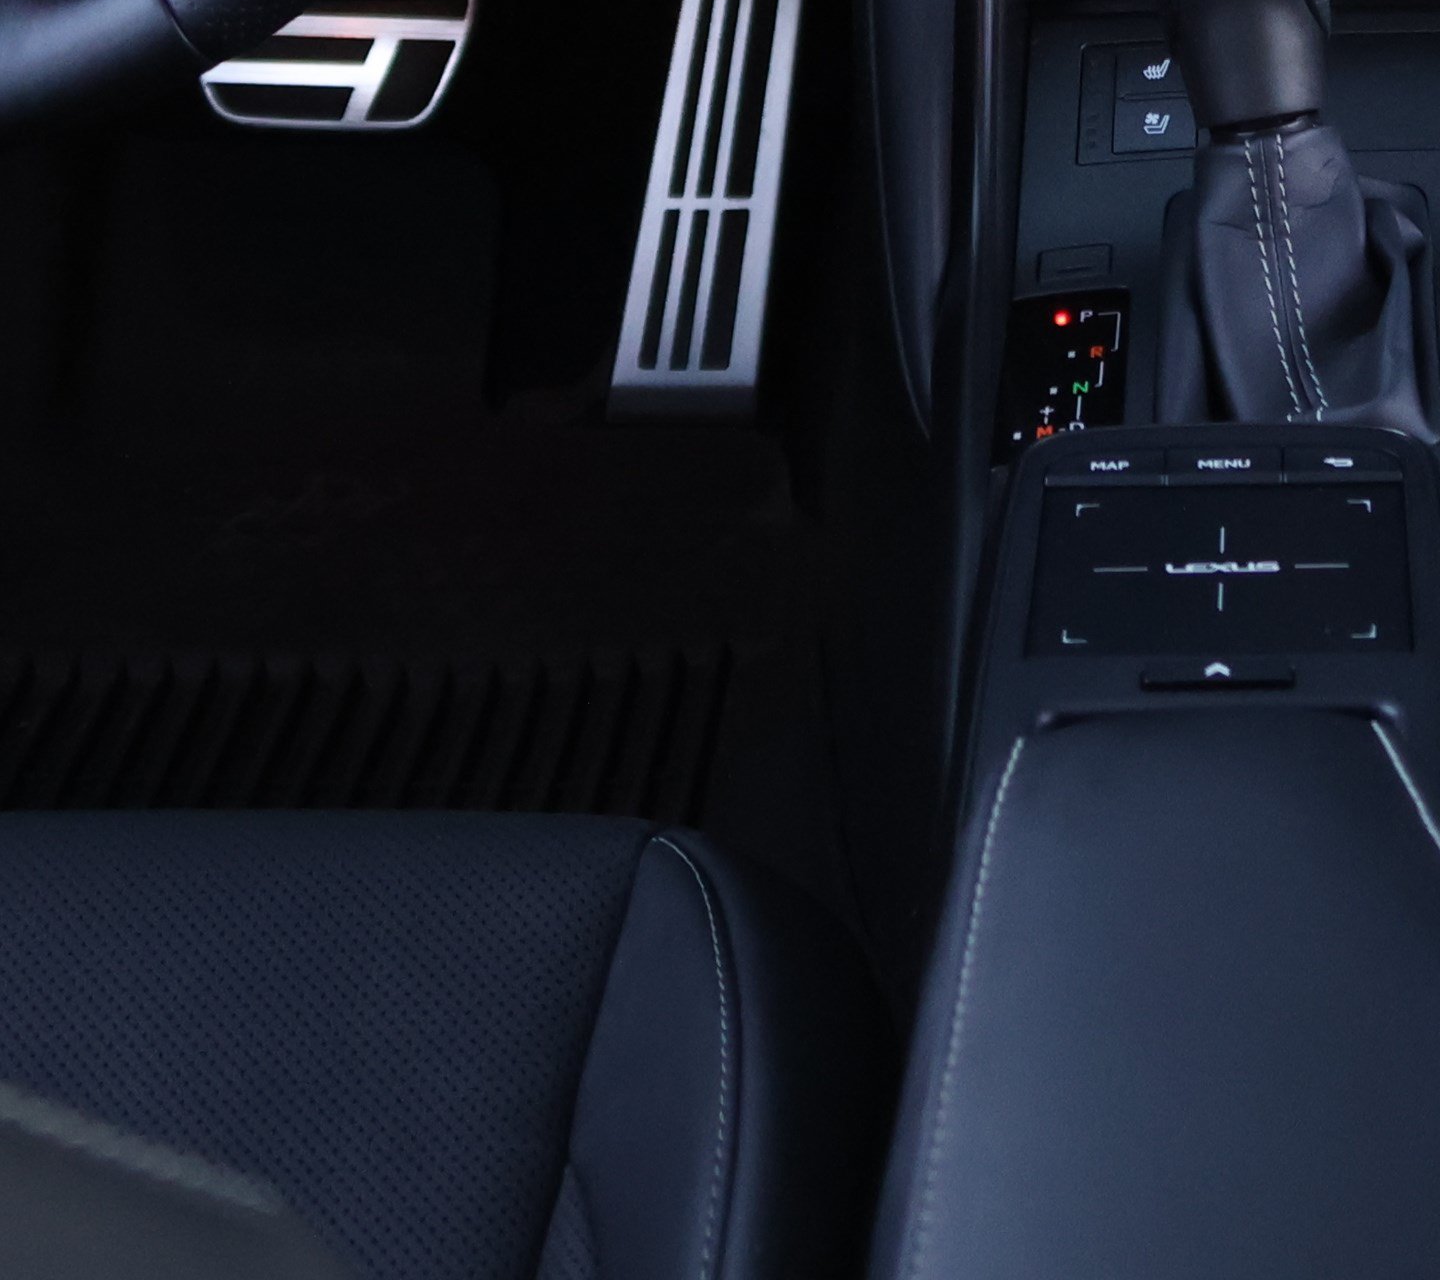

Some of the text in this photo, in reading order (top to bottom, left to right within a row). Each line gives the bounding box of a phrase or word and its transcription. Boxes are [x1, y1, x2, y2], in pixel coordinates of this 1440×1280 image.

[1080, 310, 1093, 322] P
[1090, 346, 1103, 359] R
[1072, 381, 1089, 394] N
[1036, 425, 1054, 439] M
[1090, 459, 1130, 472] MAP
[1197, 458, 1251, 470] MENU
[1165, 560, 1281, 574] LEXUS
